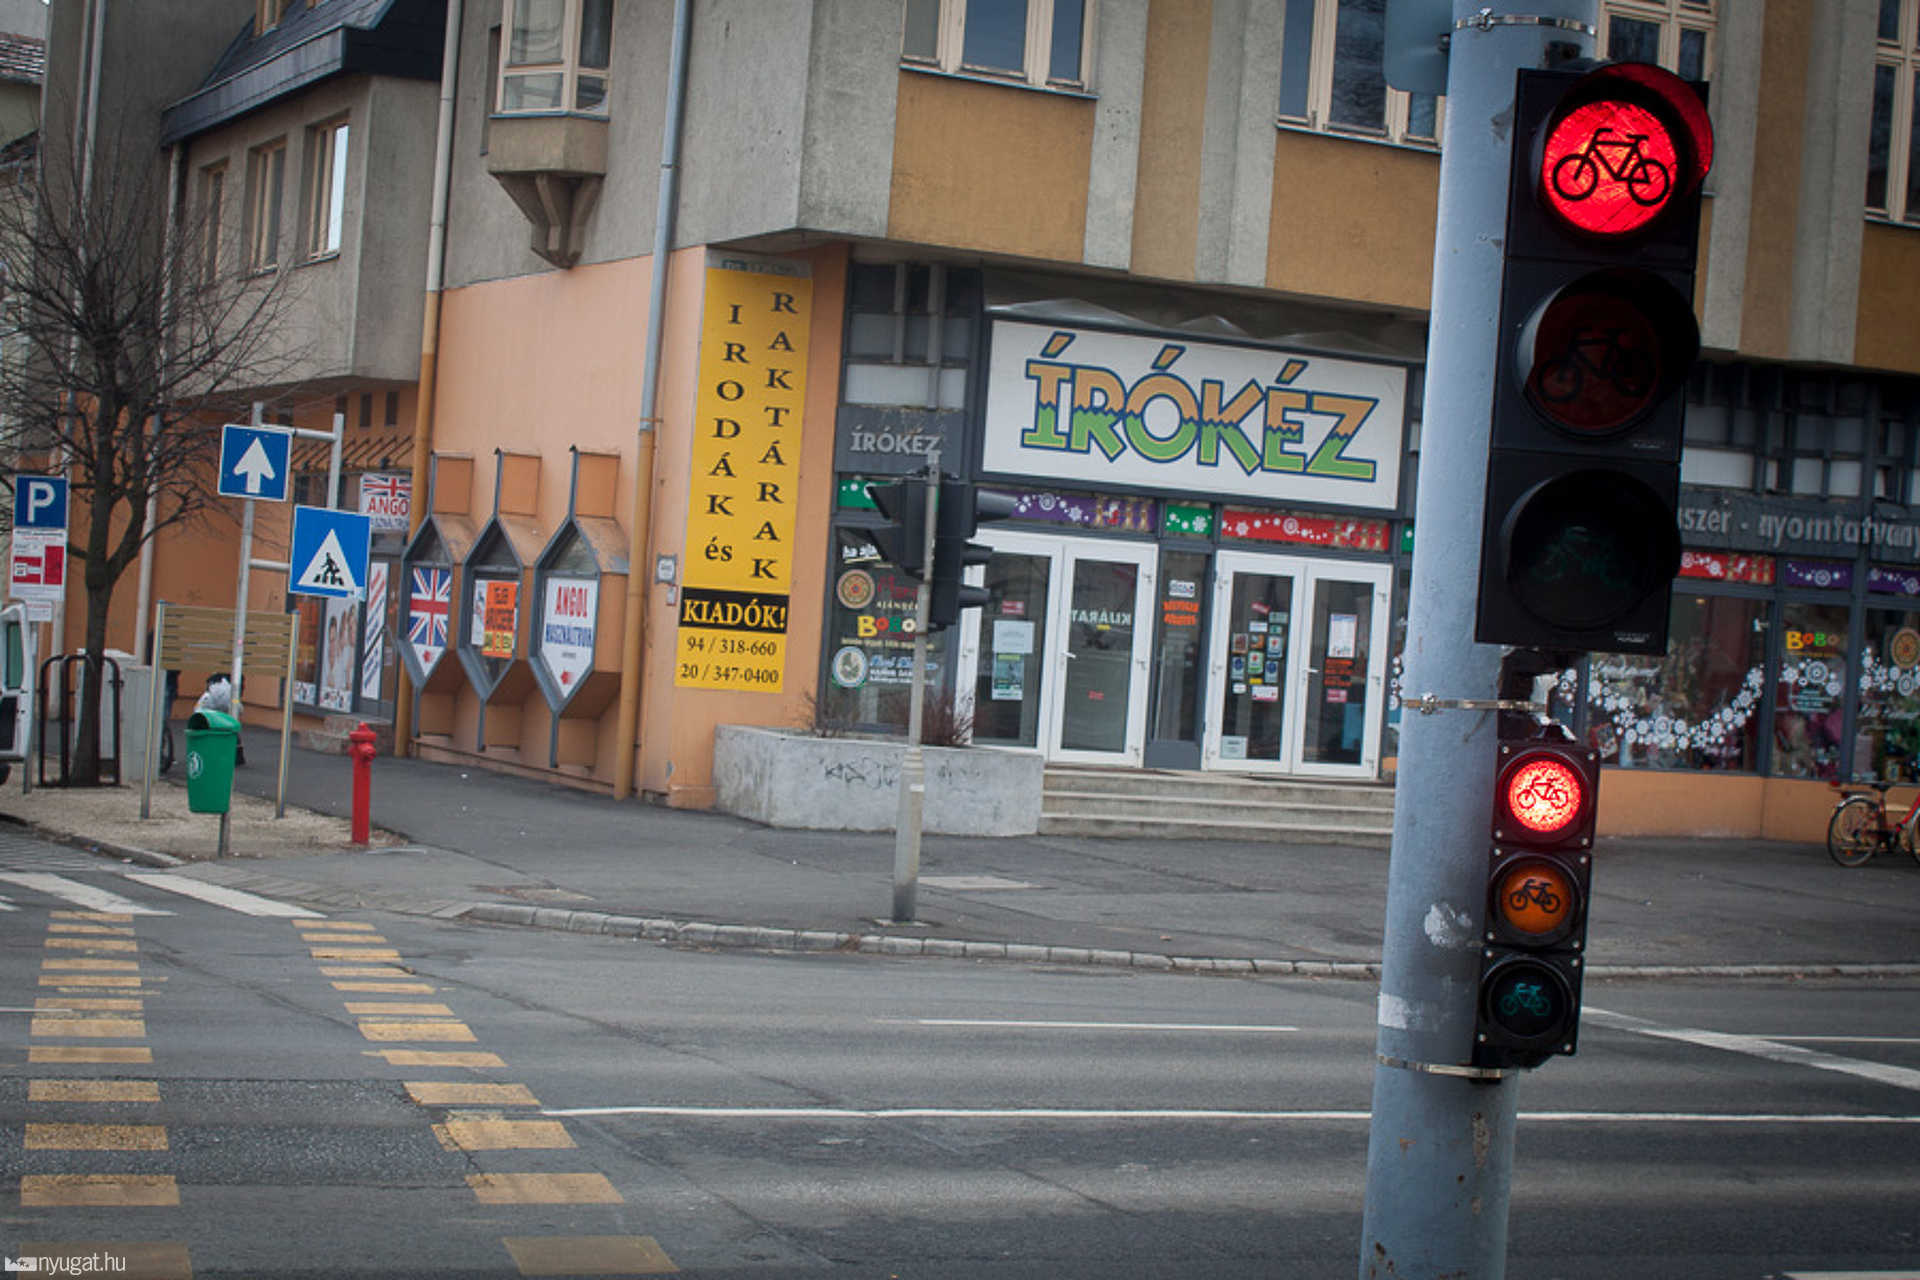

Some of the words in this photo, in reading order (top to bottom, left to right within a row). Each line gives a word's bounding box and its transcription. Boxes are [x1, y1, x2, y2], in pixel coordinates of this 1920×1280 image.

[706, 303, 750, 516] IRODÁK
[1020, 331, 1379, 482] ÍRÓKÉZ
[750, 292, 800, 580] RAKTÁRAK
[849, 424, 940, 455] ÍRÓKÉZ
[27, 481, 55, 522] P
[367, 495, 409, 516] ANGO
[1676, 506, 1732, 533] szer
[704, 536, 733, 562] és
[555, 584, 588, 617] ANGOL
[682, 598, 787, 629] KIADÓK!
[687, 635, 704, 652] 94
[719, 638, 777, 656] 318-660
[681, 663, 698, 680] 20
[713, 665, 779, 684] 347-0400
